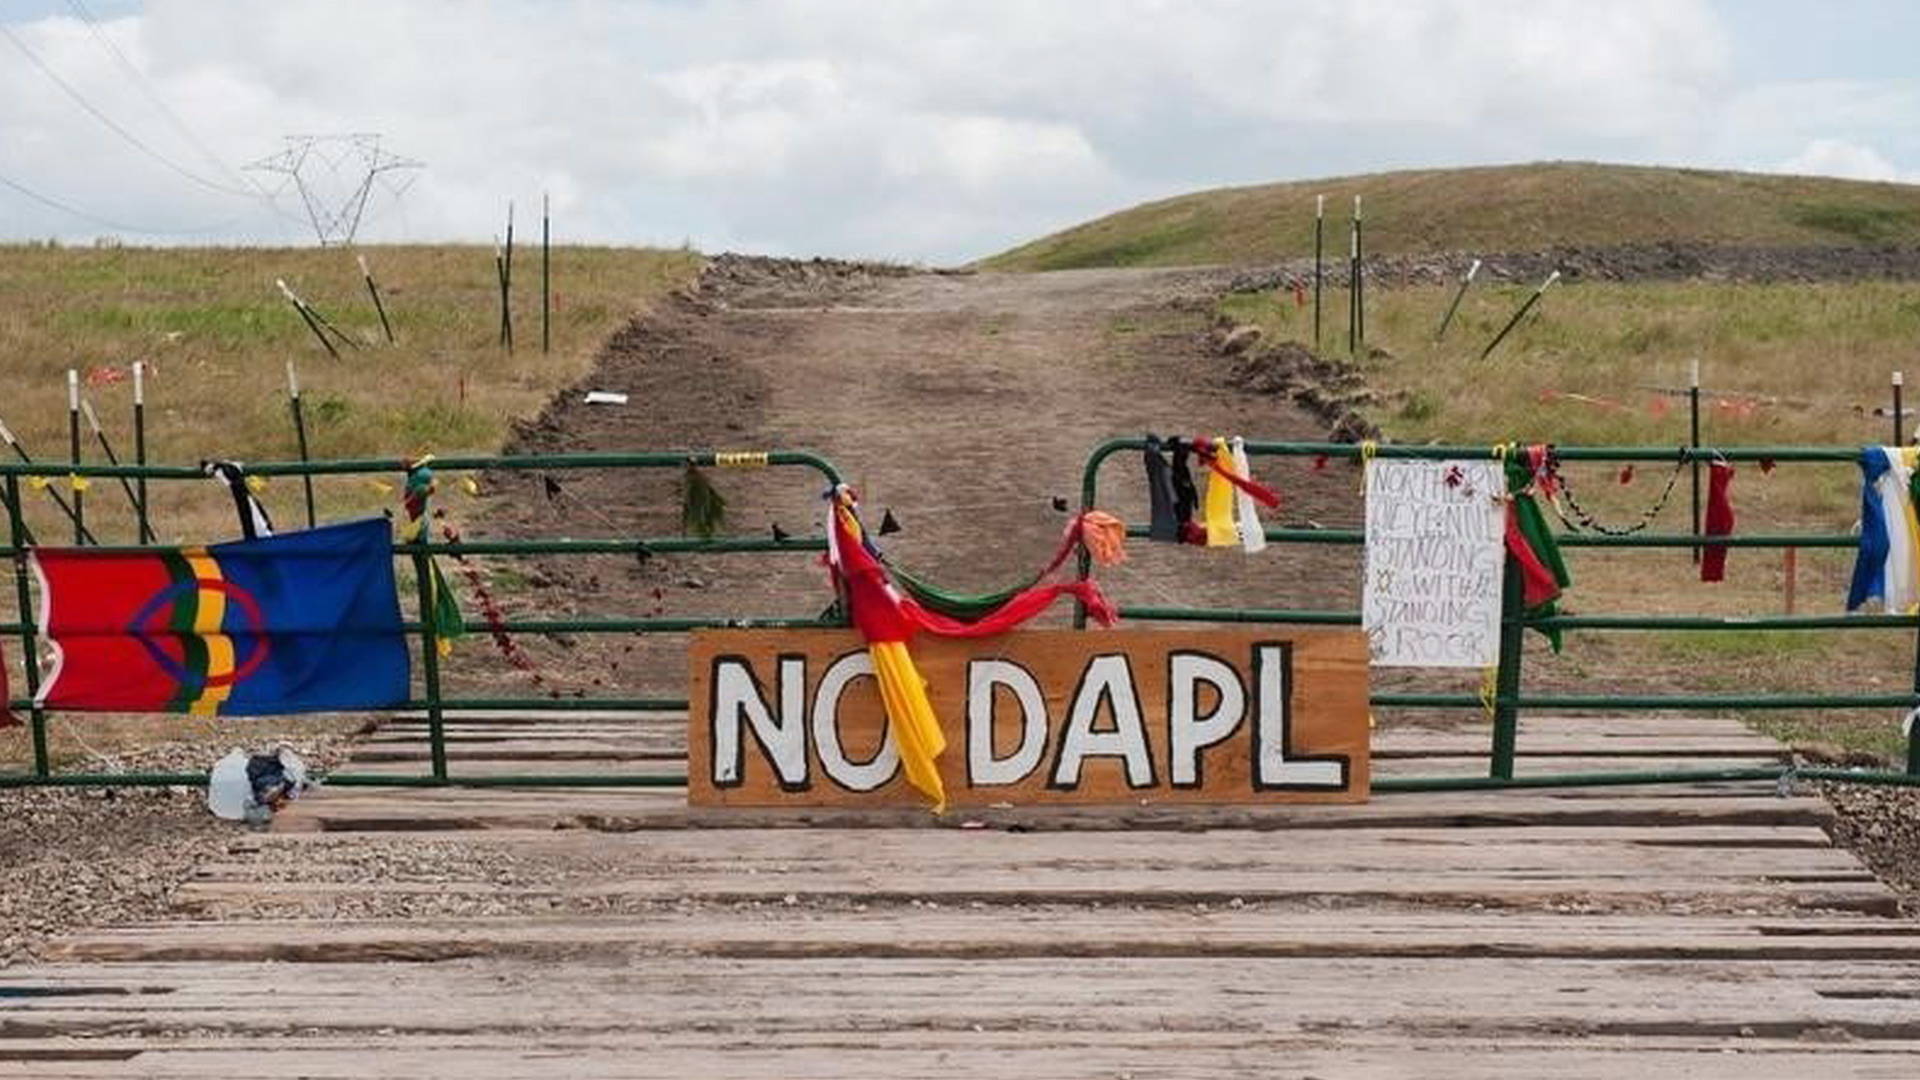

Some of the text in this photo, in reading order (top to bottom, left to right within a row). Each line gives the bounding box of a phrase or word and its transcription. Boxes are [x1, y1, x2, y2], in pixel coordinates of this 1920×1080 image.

[1373, 465, 1502, 505] NORTHRN
[1373, 537, 1498, 573] STANDING
[1411, 573, 1471, 599] WITH
[1373, 599, 1491, 630] STANDING
[1395, 627, 1490, 663] ROCK
[710, 641, 1348, 792] NO DAPL
